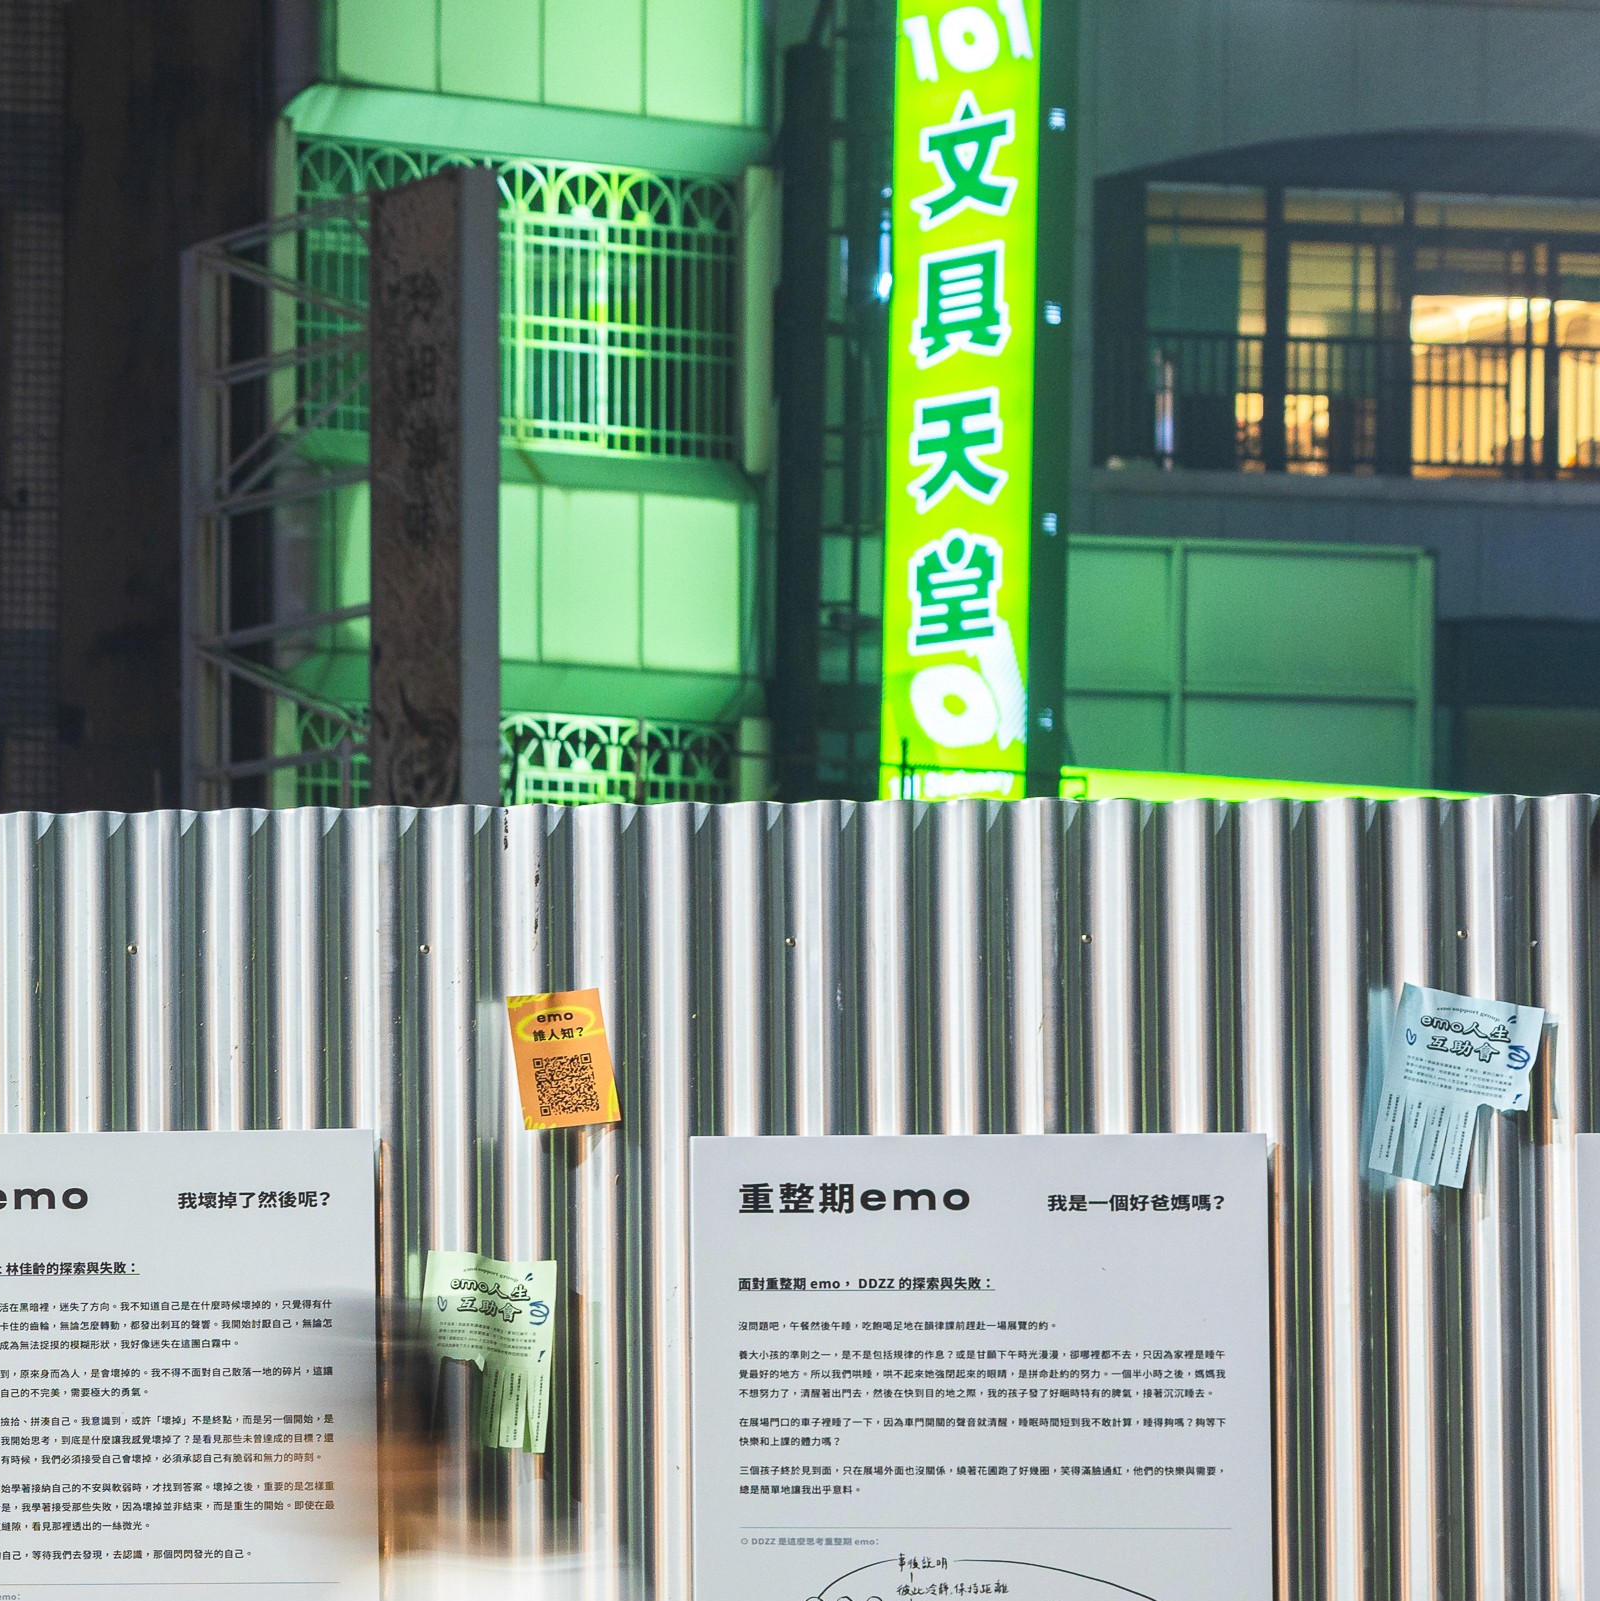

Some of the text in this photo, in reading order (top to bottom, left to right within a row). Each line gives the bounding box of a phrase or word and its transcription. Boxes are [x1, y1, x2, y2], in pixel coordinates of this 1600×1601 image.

[903, 0, 1034, 83] 101
[910, 90, 1016, 654] 文具天堂
[536, 1011, 574, 1024] emo
[531, 1026, 584, 1043] 誰人知？
[1420, 1015, 1510, 1043] emo人生
[1427, 1037, 1500, 1063] 互助會
[177, 1190, 331, 1210] 我壞掉了然後呢？
[1047, 1193, 1225, 1212] 我是一個好爸媽嗎？
[6, 1262, 138, 1276] 林佳齡的探索與失敗：
[450, 1278, 531, 1301] emo人生
[738, 1277, 806, 1290] 面對重整期
[858, 1277, 895, 1290] DDZZ
[898, 1277, 992, 1290] 的探索與失敗：
[457, 1297, 522, 1322] 互助會
[738, 1436, 840, 1447] 快樂和上課的體力嗎？
[739, 1484, 861, 1495] 總是簡單地讓我出乎意料。
[751, 1537, 776, 1546] DDZZ
[777, 1537, 853, 1546] 是這麼思考重整期
[898, 1554, 948, 1571] 事後說明
